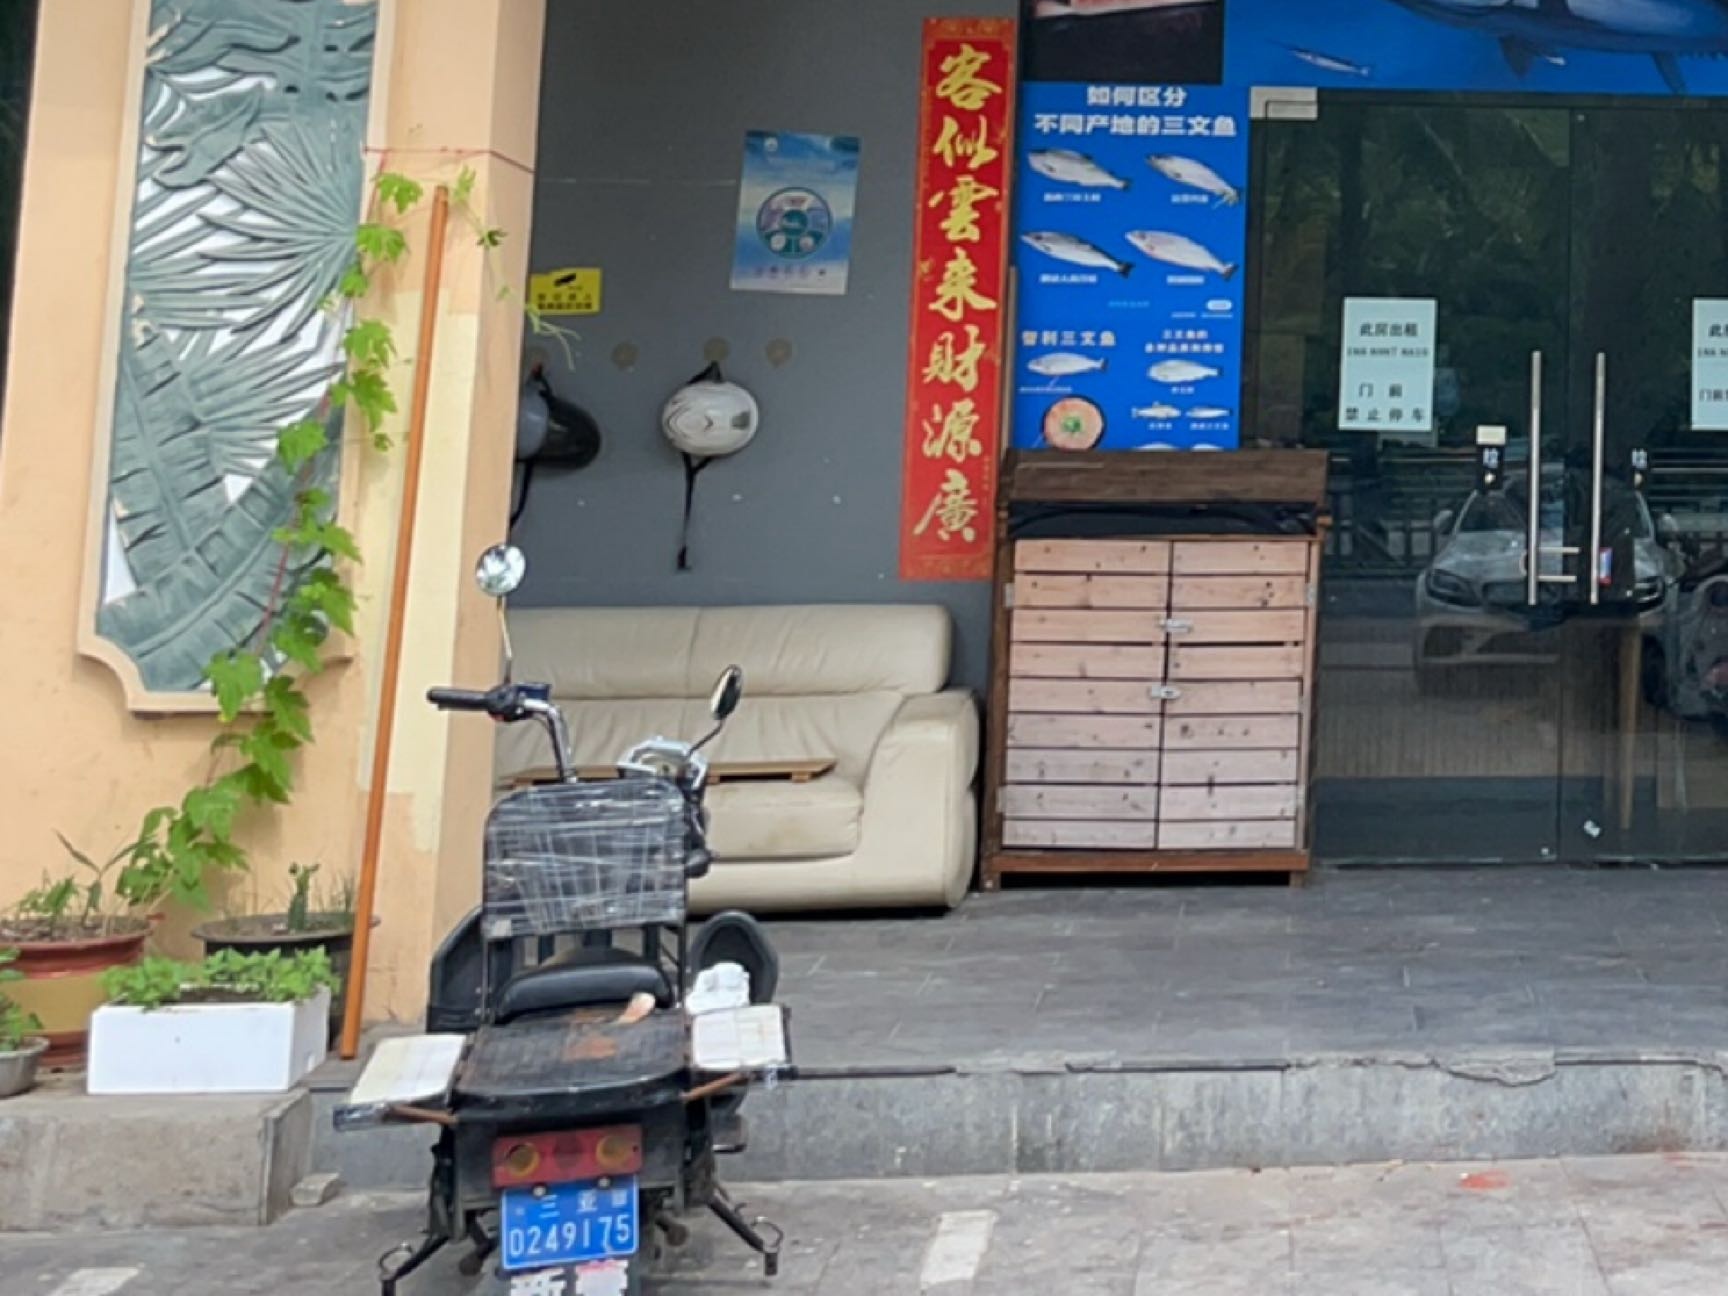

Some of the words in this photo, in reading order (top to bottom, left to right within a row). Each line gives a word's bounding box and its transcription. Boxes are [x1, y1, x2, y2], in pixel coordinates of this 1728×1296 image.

[1086, 85, 1188, 107] 如何区分
[1034, 114, 1238, 137] 不同产地的三文鱼
[509, 1214, 631, 1258] 0249175
